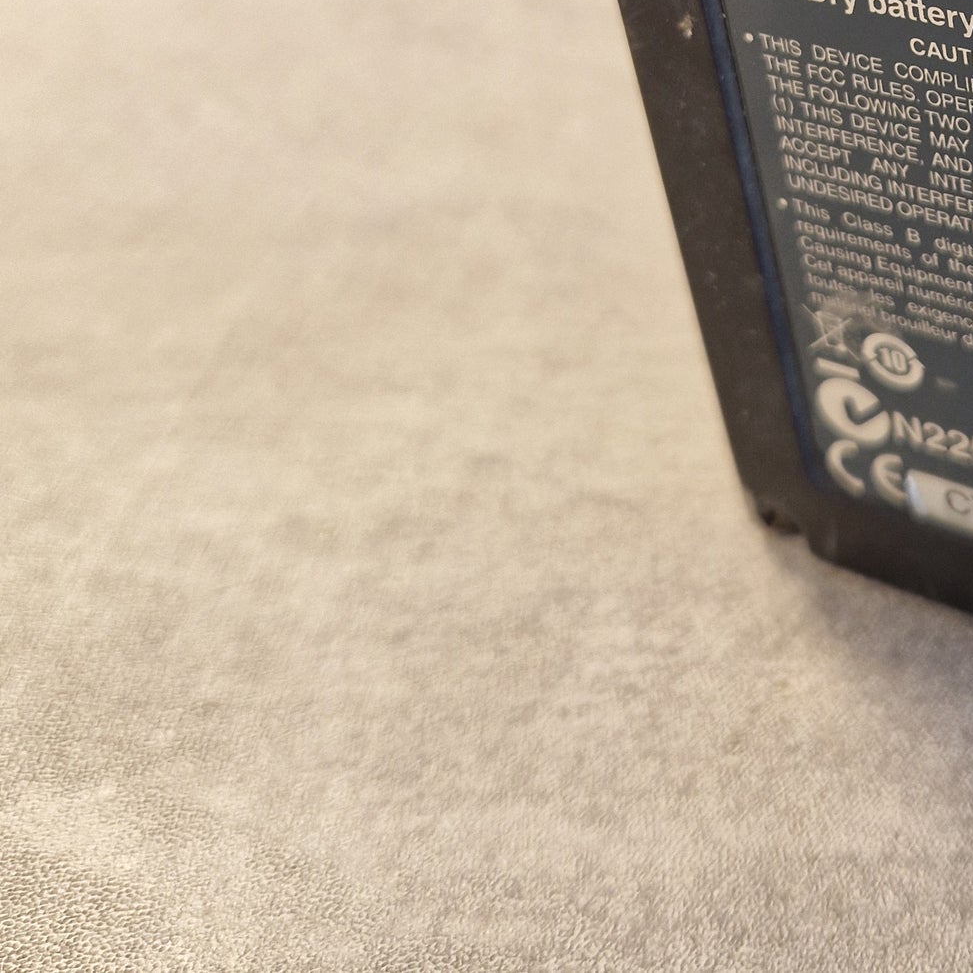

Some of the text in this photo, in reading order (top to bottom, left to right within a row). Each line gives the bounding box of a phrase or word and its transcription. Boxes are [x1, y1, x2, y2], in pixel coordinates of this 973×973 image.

[758, 32, 802, 57] THIS
[811, 44, 884, 74] DEVICE
[763, 53, 802, 76] THE
[806, 63, 846, 86] FCC
[851, 73, 920, 102] RULES.
[767, 74, 806, 97] THE
[808, 83, 922, 123] FOLLOWING
[924, 109, 971, 134] TWO
[771, 94, 794, 115] (1)
[800, 101, 844, 125] THIS
[850, 112, 922, 143] DEVICE
[929, 130, 970, 153] MAY
[776, 115, 924, 165] INTERFERENCE,
[931, 151, 973, 174] AND
[780, 135, 852, 165] ACCEPT
[871, 156, 909, 178] ANY
[784, 154, 883, 192] INCLUDING
[787, 173, 894, 212] UNDESIRED
[792, 197, 831, 221] This
[842, 211, 894, 238] Class
[906, 227, 921, 244] B
[796, 219, 912, 260] requirements
[920, 252, 939, 267] of
[799, 235, 873, 270] Causing
[876, 255, 973, 295] Equipment
[803, 252, 834, 273] Cet
[836, 265, 905, 293] appareil
